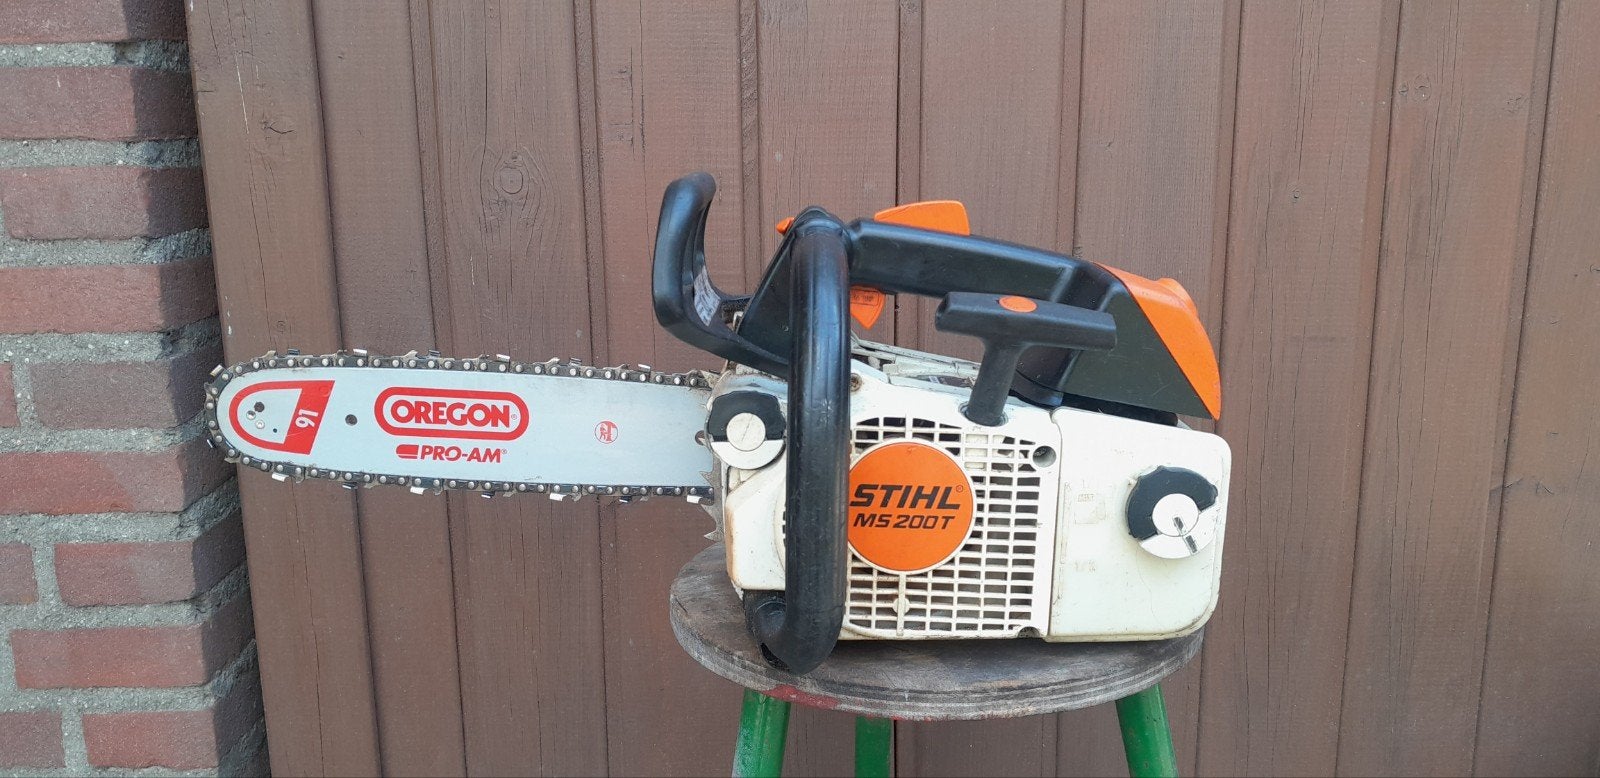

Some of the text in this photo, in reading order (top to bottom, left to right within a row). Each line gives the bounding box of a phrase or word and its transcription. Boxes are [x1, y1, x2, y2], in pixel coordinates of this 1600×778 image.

[295, 409, 319, 428] 91
[391, 400, 510, 428] OREGON
[420, 445, 501, 463] PRO-AM
[850, 484, 960, 510] STIHL
[854, 513, 892, 528] MS
